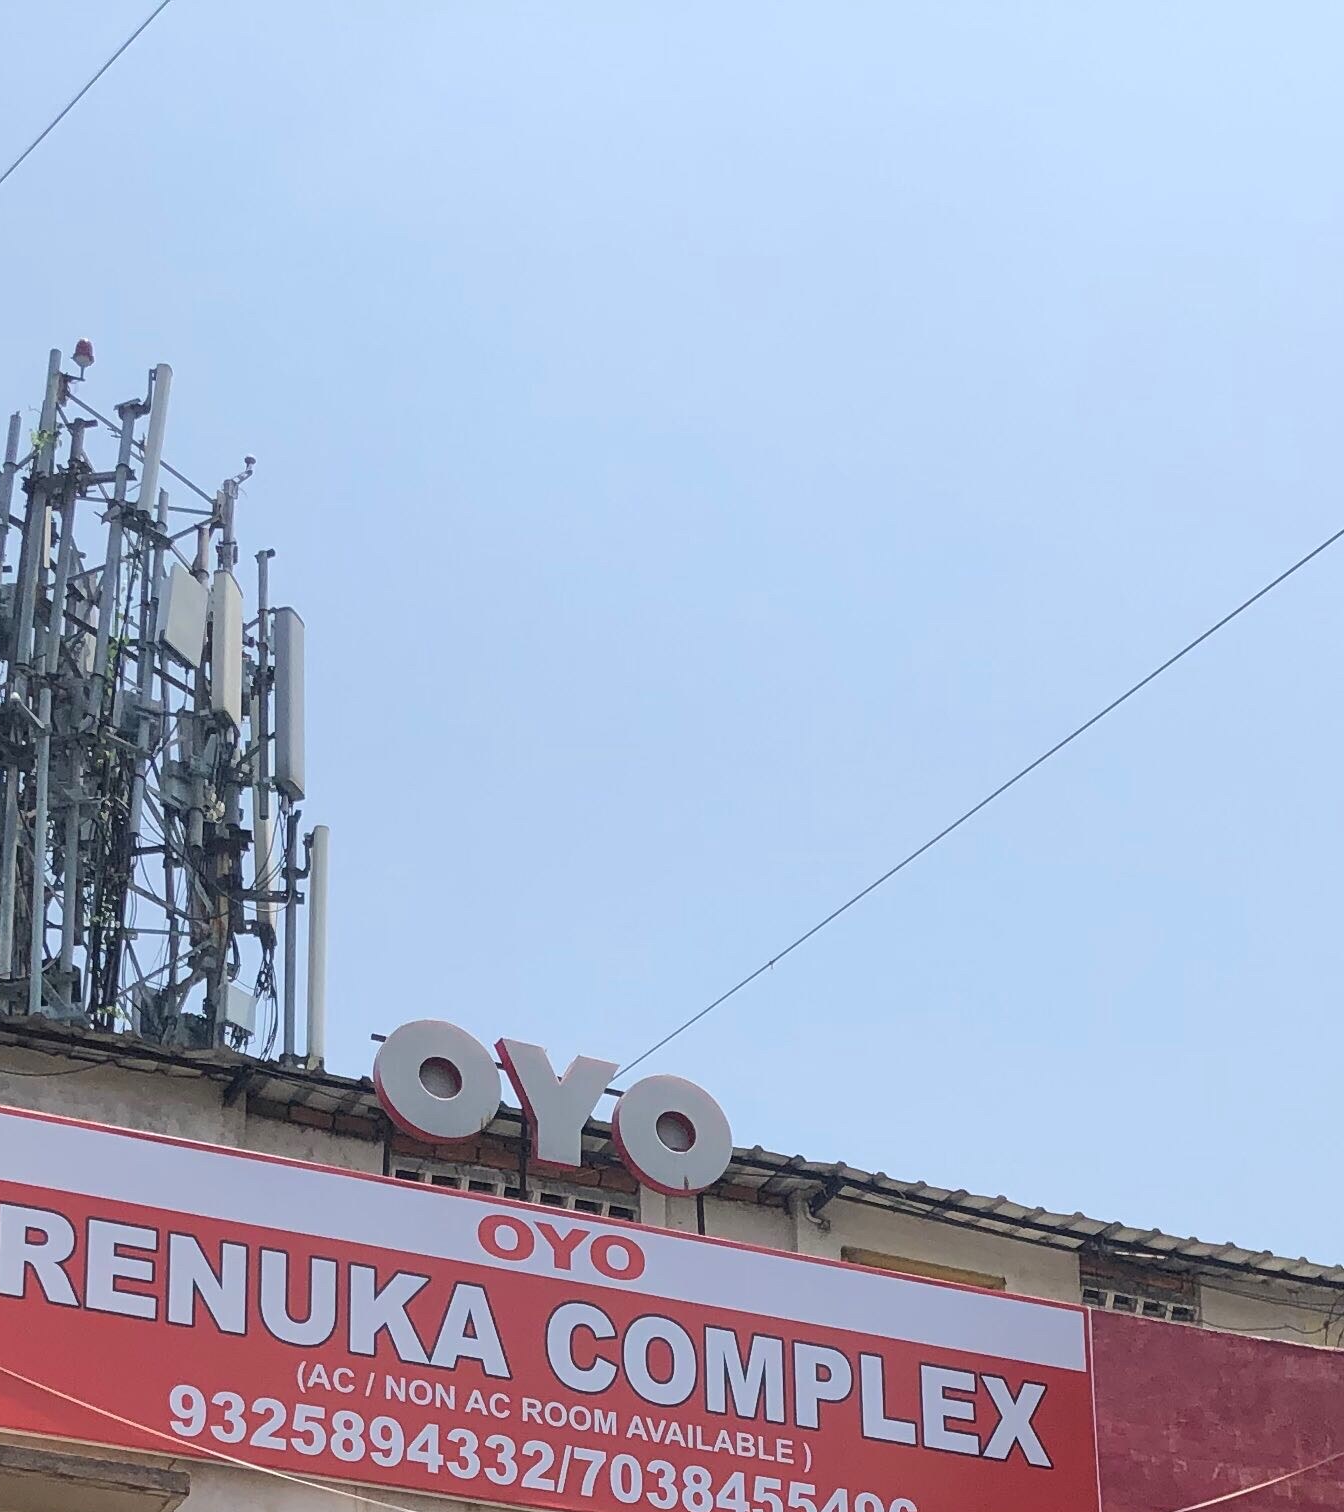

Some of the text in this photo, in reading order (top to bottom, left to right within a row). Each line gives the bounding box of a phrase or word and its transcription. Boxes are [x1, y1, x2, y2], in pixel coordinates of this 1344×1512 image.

[373, 1018, 733, 1197] OYO
[476, 1213, 646, 1282] OYO
[385, 1376, 457, 1412] NON
[466, 1390, 511, 1419] AC
[522, 1396, 618, 1437] ROOM
[626, 1414, 795, 1466] AVAILABLE
[546, 1300, 1054, 1470] COMPLEX
